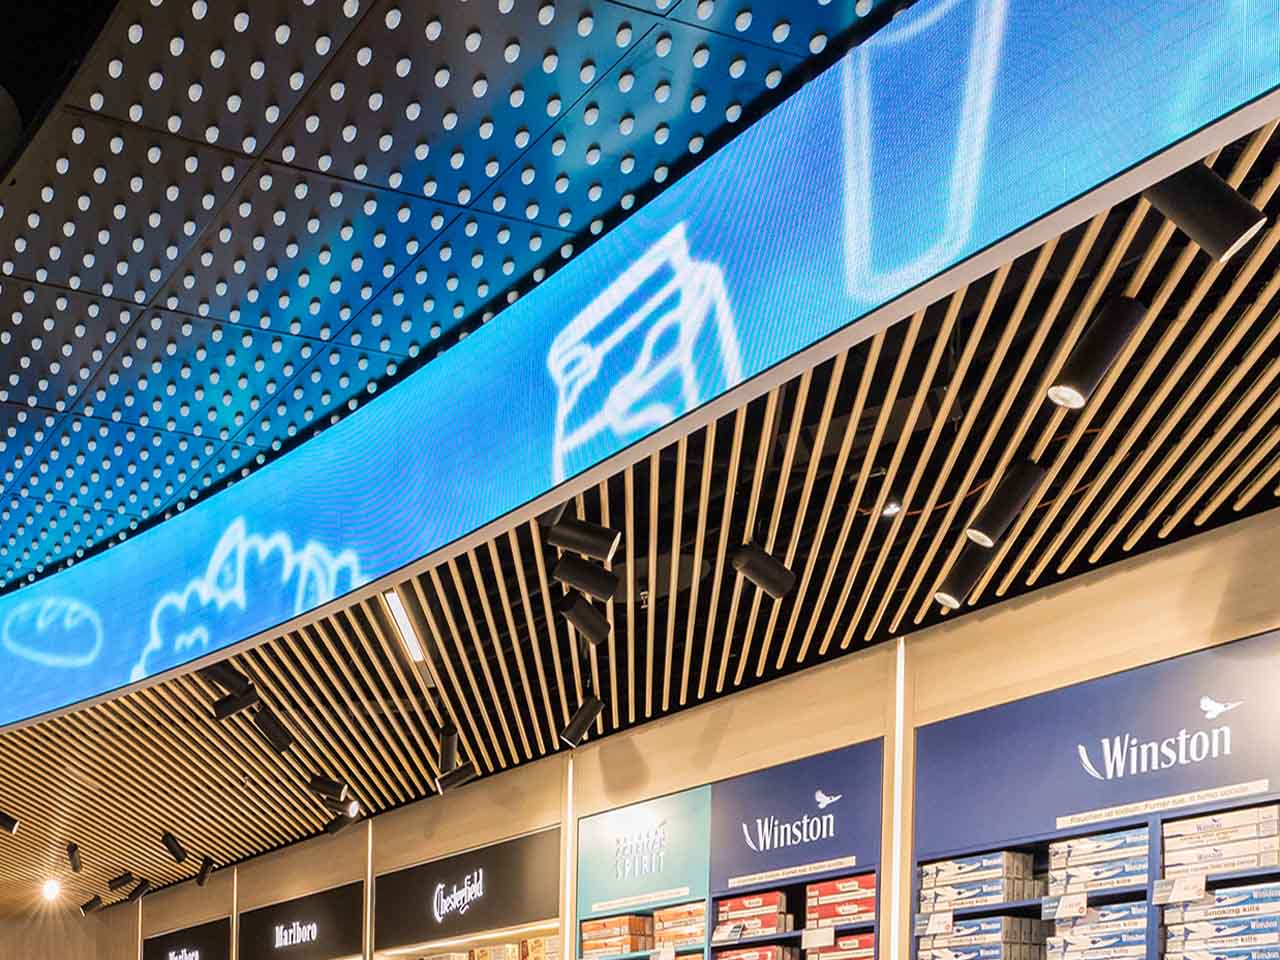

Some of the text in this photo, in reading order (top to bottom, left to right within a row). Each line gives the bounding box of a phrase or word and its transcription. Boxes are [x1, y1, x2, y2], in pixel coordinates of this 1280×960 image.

[1077, 725, 1232, 780] Winston
[743, 813, 834, 851] Winston
[433, 868, 484, 923] Chesterfield
[275, 921, 317, 948] Marlboro
